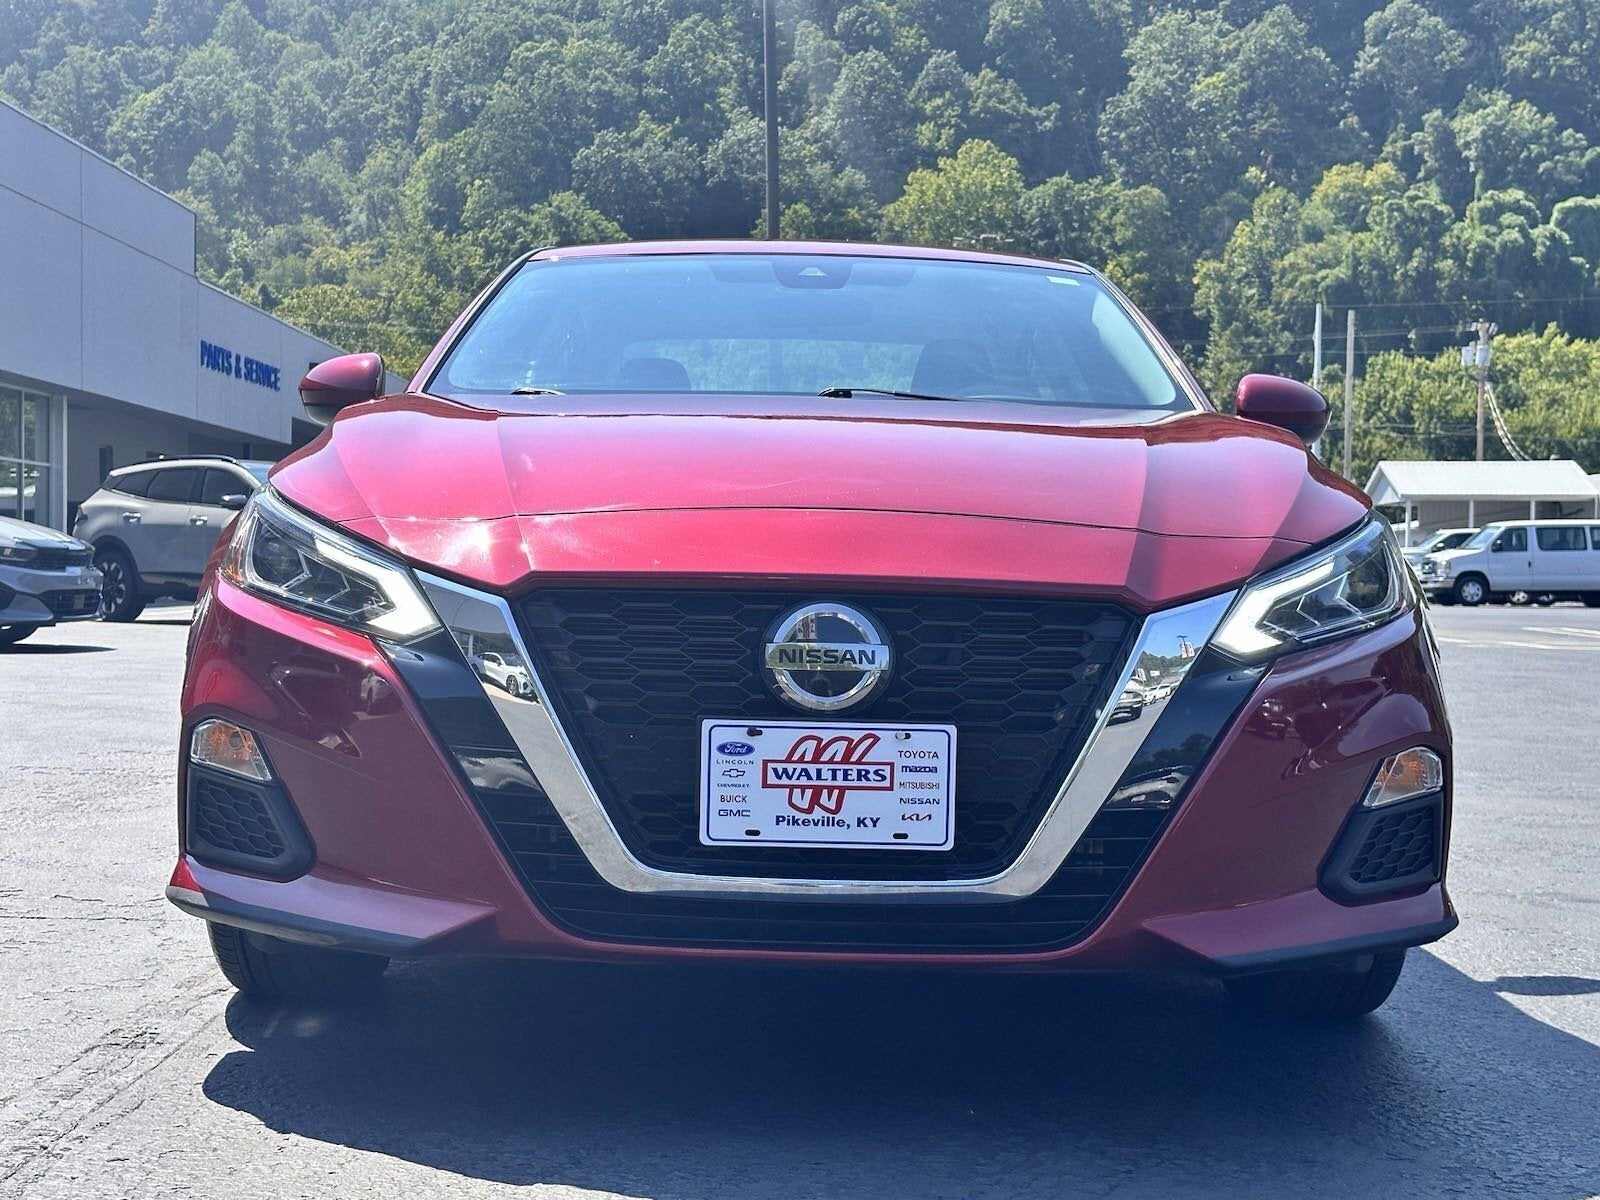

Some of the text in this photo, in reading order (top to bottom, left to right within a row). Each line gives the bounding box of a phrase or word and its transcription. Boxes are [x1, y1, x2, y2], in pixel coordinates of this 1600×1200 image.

[200, 339, 281, 393] PARTS & SERVICE
[778, 648, 876, 665] NISSAN
[898, 750, 939, 760] TOYOTA
[771, 767, 888, 783] WALTERS
[898, 781, 940, 790] MITSUBISHI
[720, 794, 748, 803] BUICK
[899, 797, 940, 805] NISSAN
[718, 809, 751, 817] GMC
[775, 815, 881, 830] Pikeville, KY
